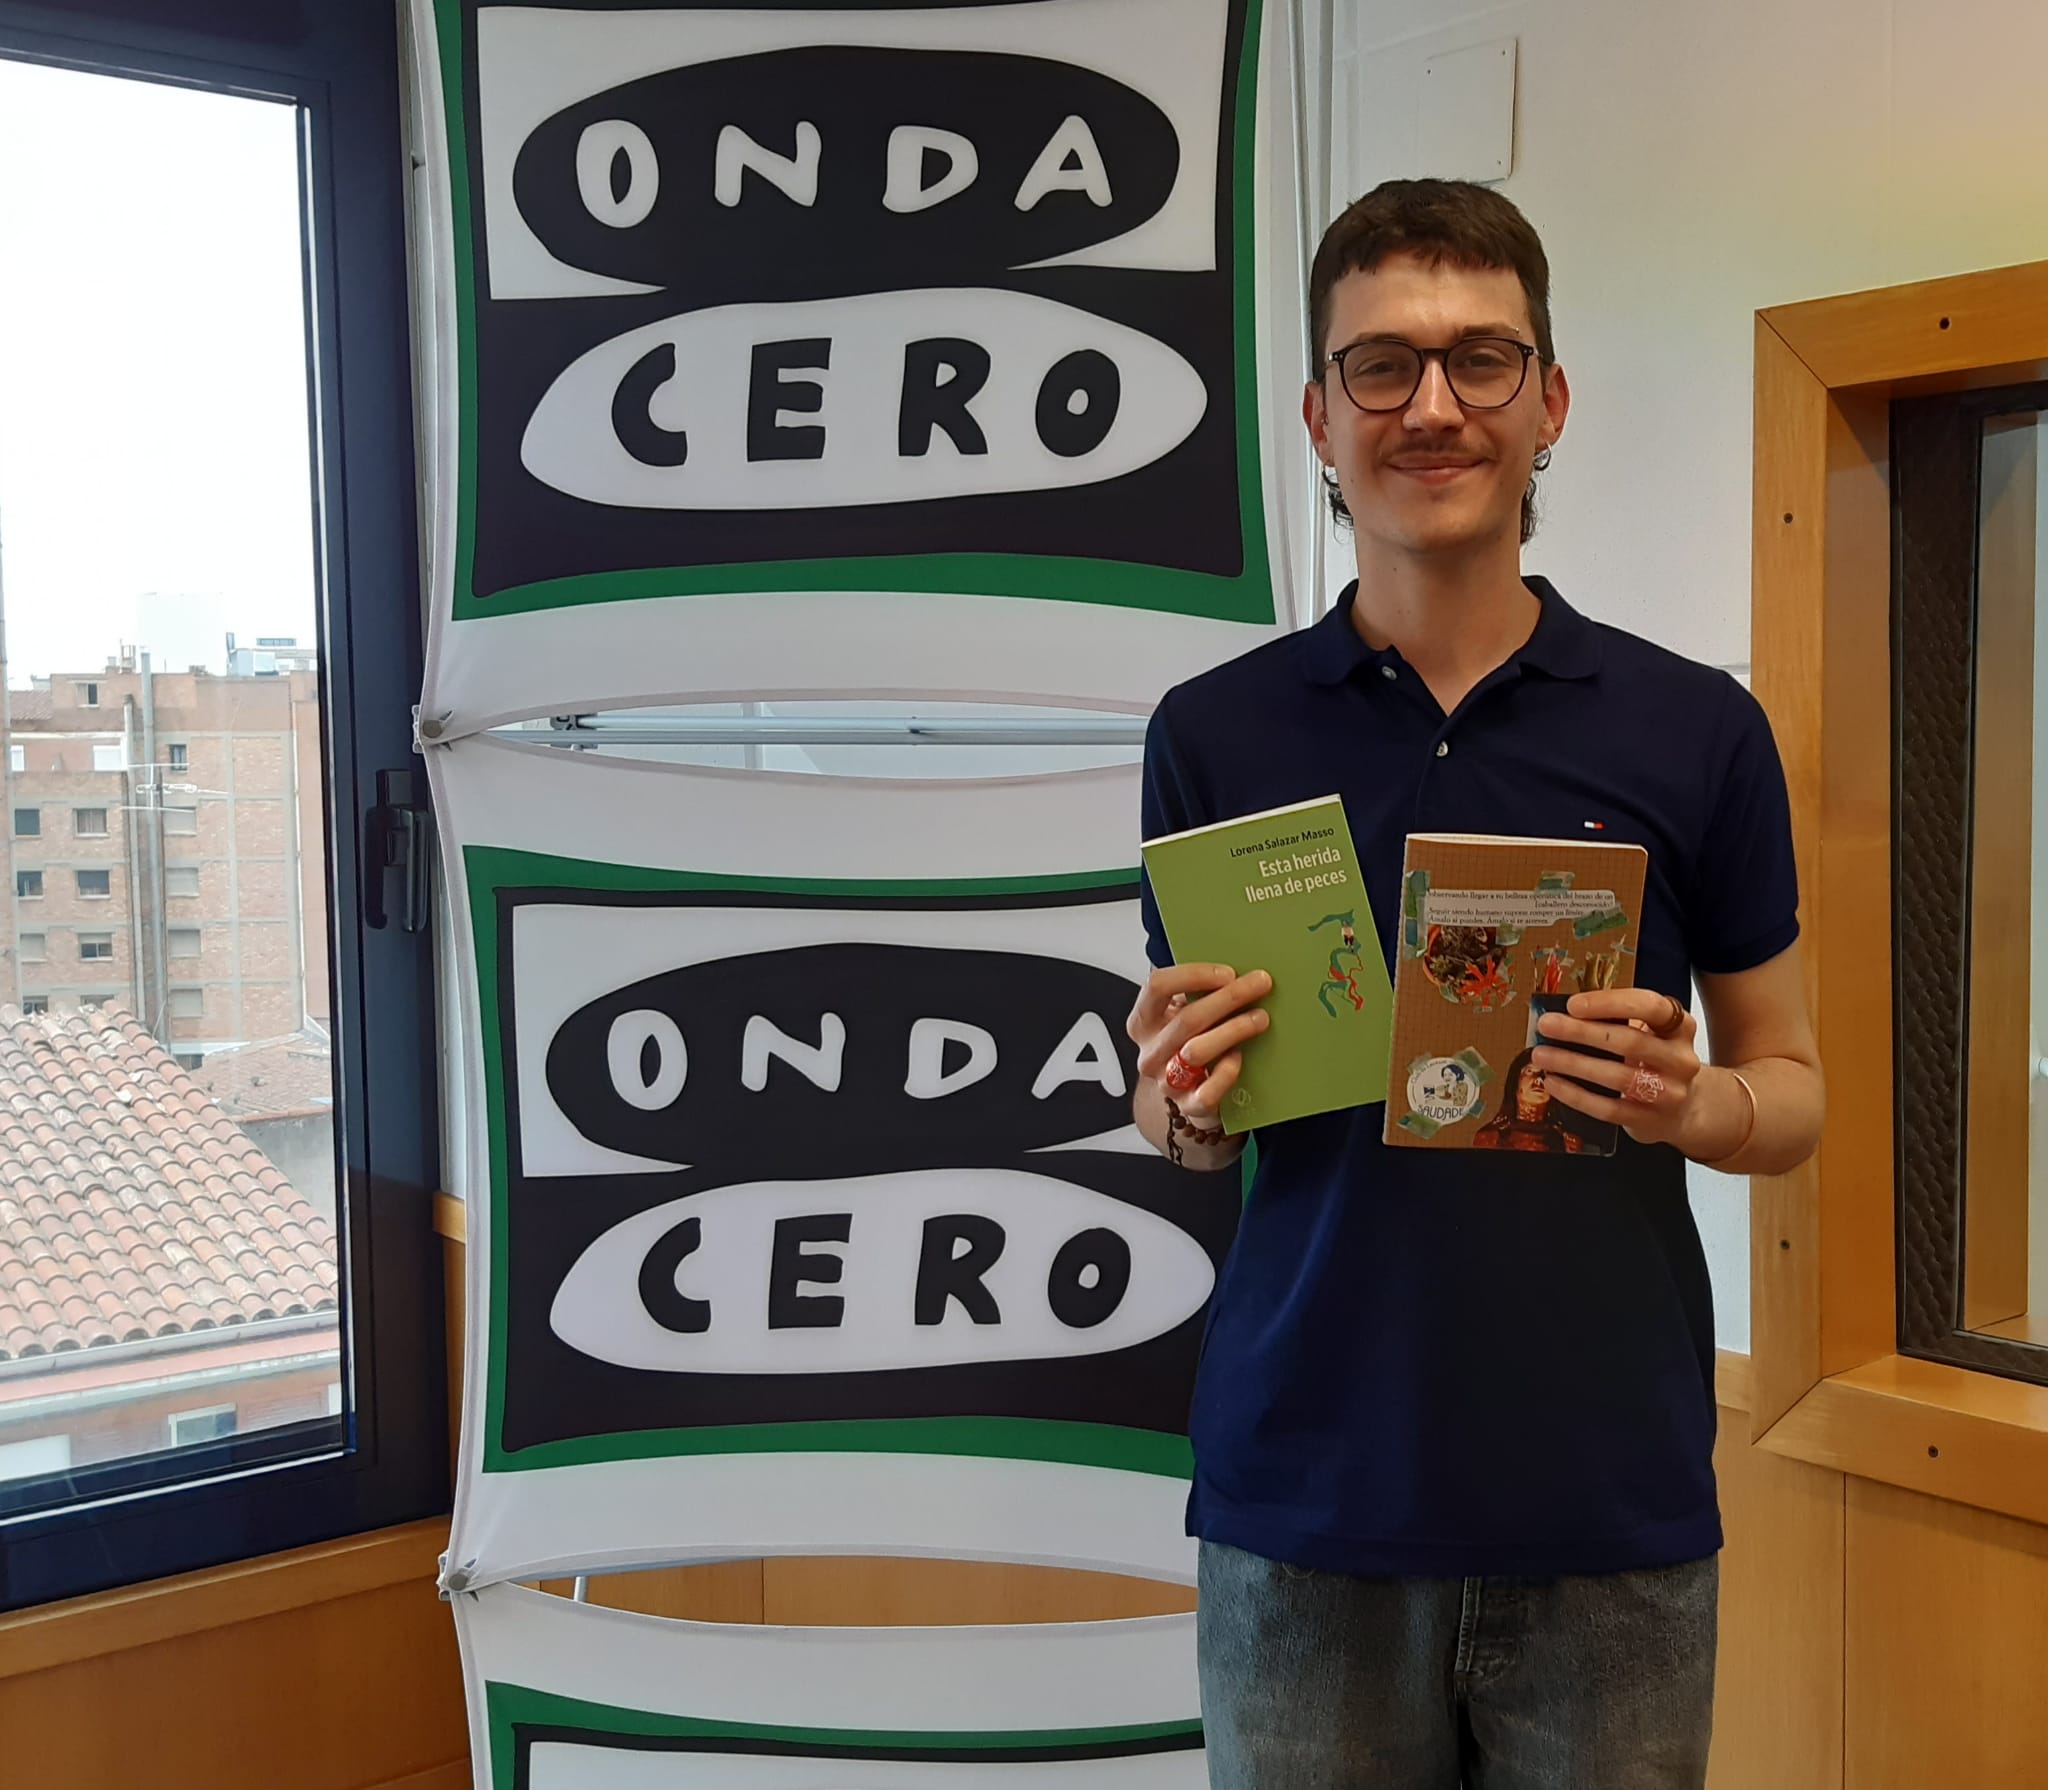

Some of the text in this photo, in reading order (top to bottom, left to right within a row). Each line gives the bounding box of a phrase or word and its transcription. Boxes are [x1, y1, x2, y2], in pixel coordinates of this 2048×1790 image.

[574, 114, 1113, 229] ONDA
[611, 336, 1121, 466] CERO
[1230, 828, 1335, 857] Lorena Salazar Masso
[1245, 869, 1347, 903] llena de peces
[1259, 846, 1341, 878] Esta herida
[607, 1009, 1127, 1111] ONDA
[638, 1212, 1131, 1334] CERO
